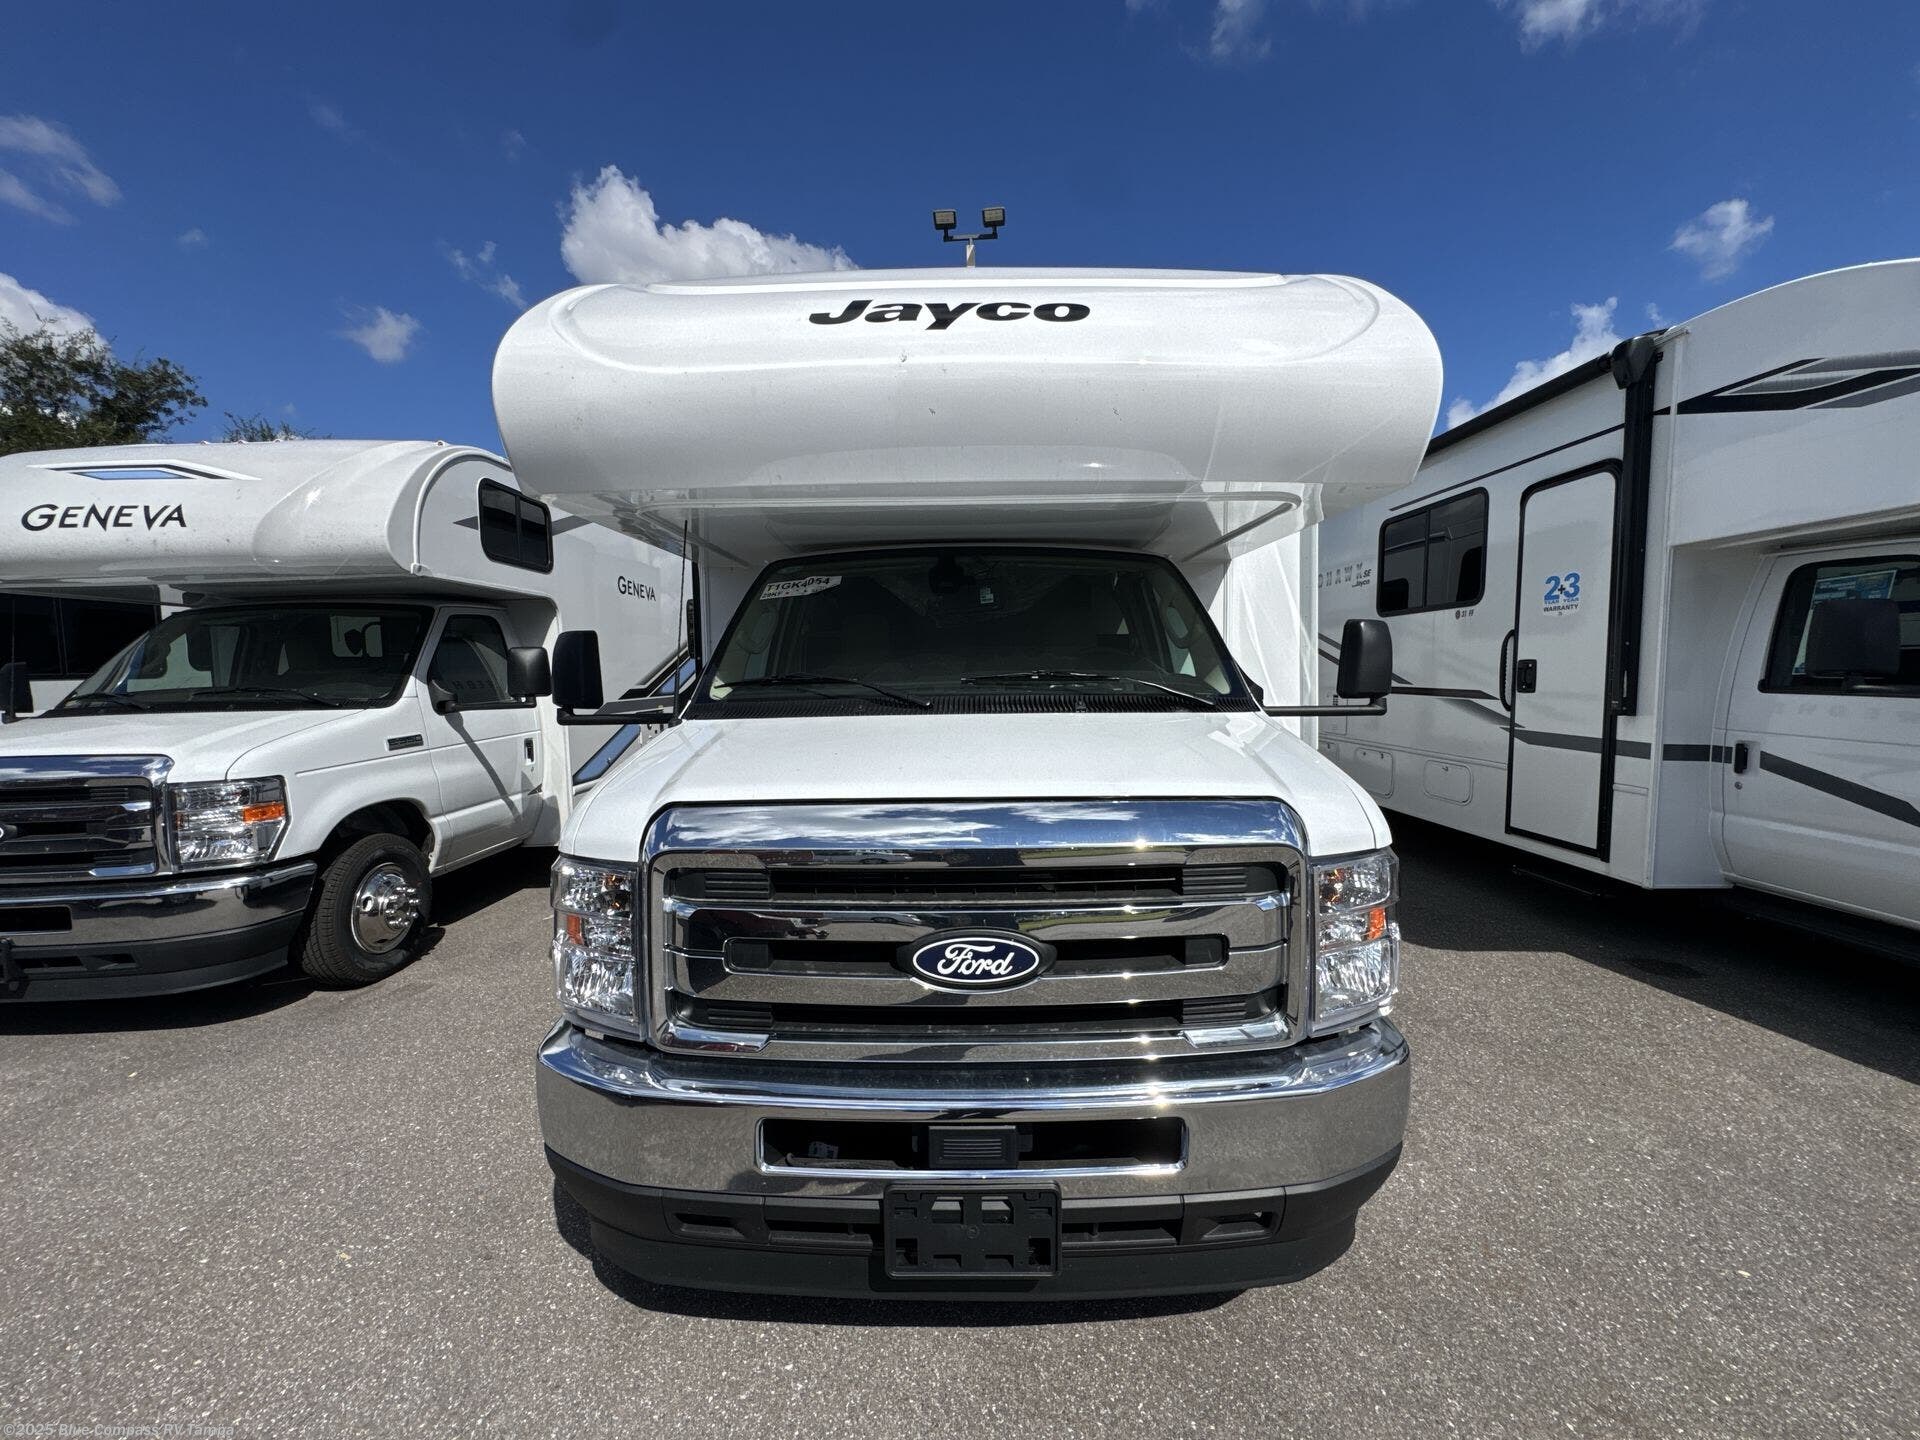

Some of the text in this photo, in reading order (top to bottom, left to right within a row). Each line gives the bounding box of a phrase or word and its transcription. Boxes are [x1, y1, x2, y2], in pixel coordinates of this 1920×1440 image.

[809, 299, 1091, 331] Jayco
[21, 503, 187, 532] GENEVA
[617, 575, 657, 602] GENEVA
[1543, 603, 1579, 612] WARRANTY
[937, 943, 1015, 975] Ford
